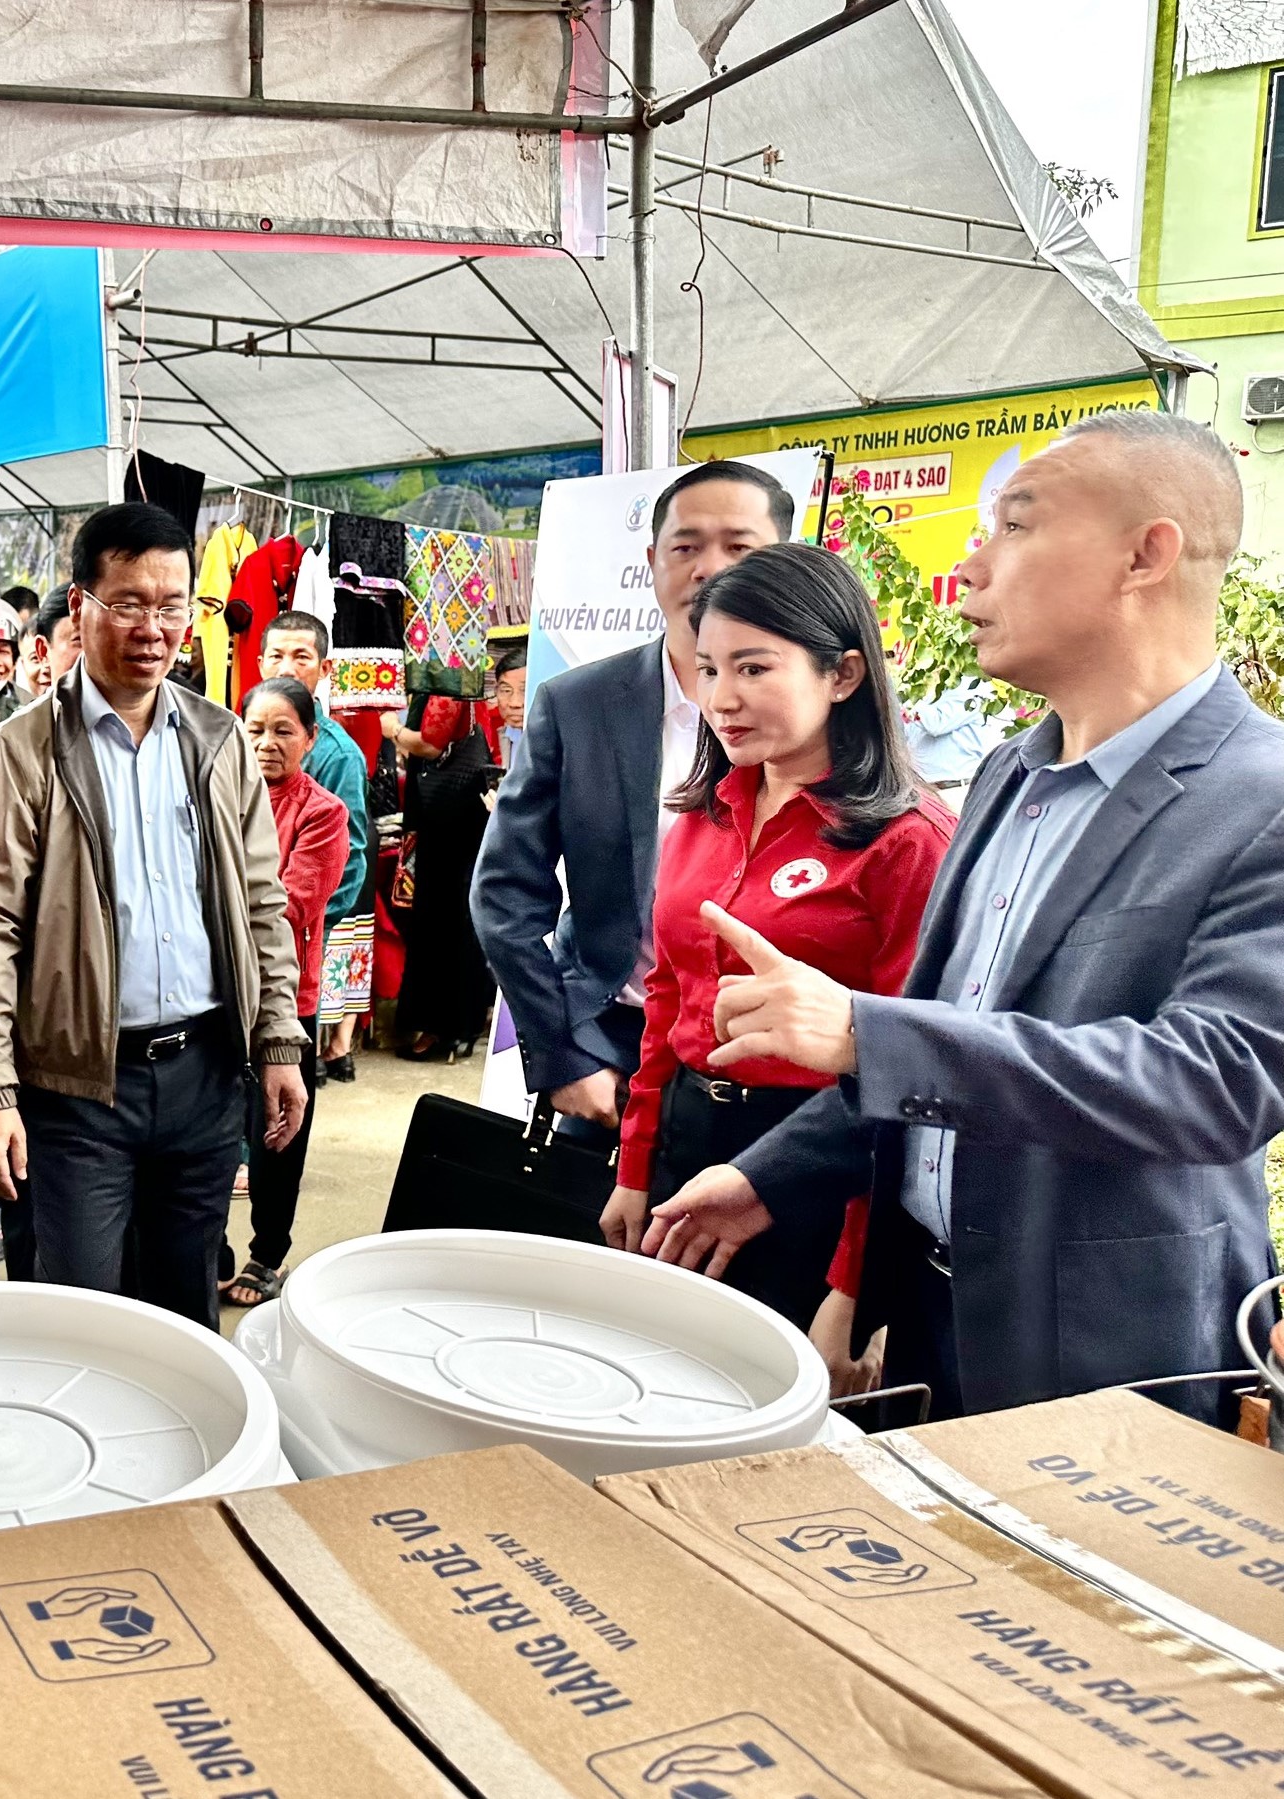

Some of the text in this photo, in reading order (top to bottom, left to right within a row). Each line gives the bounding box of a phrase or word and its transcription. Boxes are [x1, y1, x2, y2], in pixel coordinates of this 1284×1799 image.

[832, 435, 850, 453] TY
[854, 430, 899, 451] TNHH
[903, 421, 970, 446] HƯƠNG
[976, 407, 1027, 438] TRẦM
[1032, 404, 1073, 432] BẢY
[874, 469, 901, 495] ĐẠT
[903, 469, 913, 489] 4
[917, 465, 947, 489] SAO
[825, 503, 914, 530] OOP
[538, 603, 601, 631] CHUYÊN
[602, 608, 631, 632] GIA
[1140, 1474, 1190, 1497] TAY
[1143, 1517, 1248, 1559] RẤT
[1237, 1517, 1284, 1544] ÒNG
[371, 1507, 633, 1718] HÀNG RẤT DỄ VỠ
[484, 1532, 638, 1653] VUI LÒNG NHẸ TAY
[956, 1609, 1092, 1674] HÀNG
[1080, 1677, 1200, 1725] RẤT
[970, 1652, 1019, 1676] VUI
[1010, 1677, 1087, 1716] LÒNG
[1145, 1749, 1210, 1779] TAY
[152, 1697, 256, 1781] HÀNG
[120, 1754, 162, 1785] VUI
